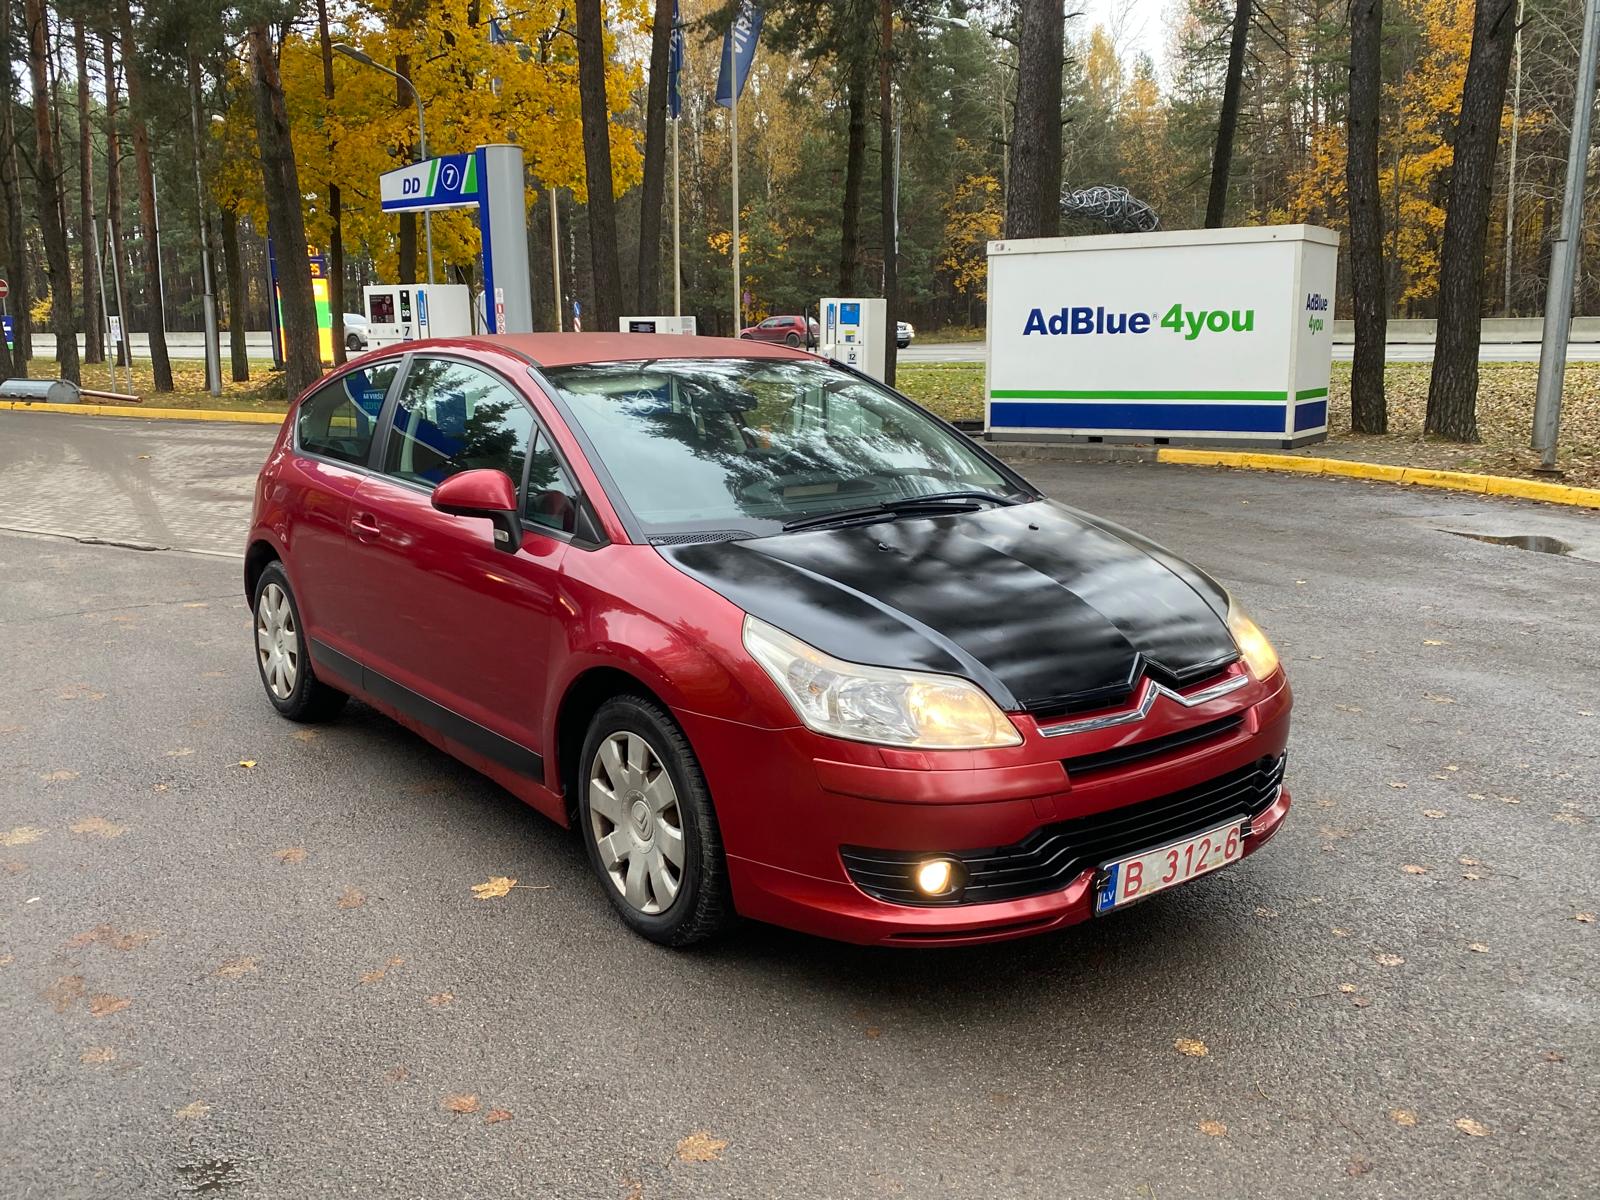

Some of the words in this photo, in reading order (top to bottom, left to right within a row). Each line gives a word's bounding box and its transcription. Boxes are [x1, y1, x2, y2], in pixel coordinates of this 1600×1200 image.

[403, 177, 420, 194] DD
[446, 169, 455, 185] 7
[1306, 293, 1328, 311] AdBlue
[1160, 304, 1255, 340] 4you
[1308, 314, 1324, 335] 4you
[404, 326, 410, 336] 7
[1123, 861, 1143, 899] B
[1162, 827, 1240, 883] 312-6
[1102, 890, 1115, 903] LV
